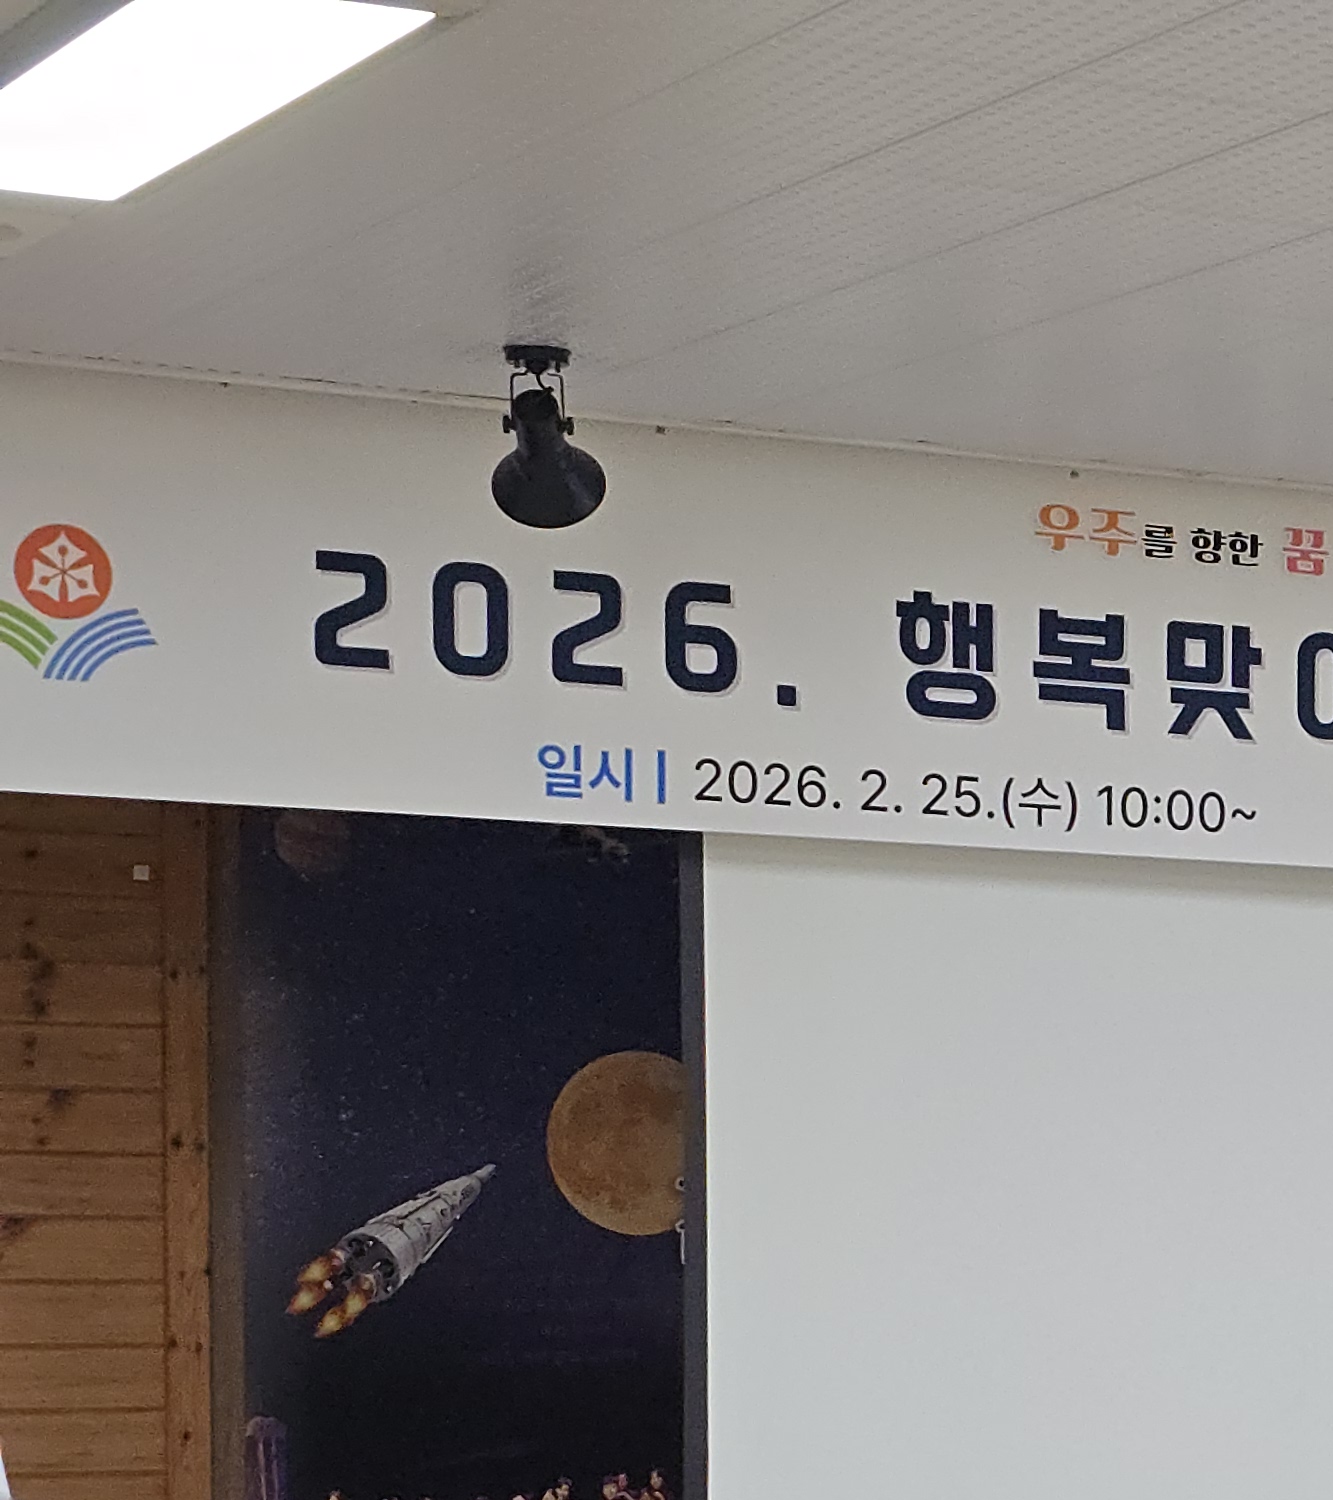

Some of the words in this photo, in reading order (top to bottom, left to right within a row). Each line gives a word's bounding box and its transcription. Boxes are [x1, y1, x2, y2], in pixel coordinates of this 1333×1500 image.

[1035, 504, 1177, 558] 우주를
[1190, 527, 1263, 566] 향한
[1281, 526, 1329, 576] 꿈
[313, 550, 799, 710] 2026.
[537, 745, 634, 803] 일시
[693, 758, 841, 811] 2026.
[860, 769, 903, 814] 2.
[1098, 785, 1257, 833] 10:00~
